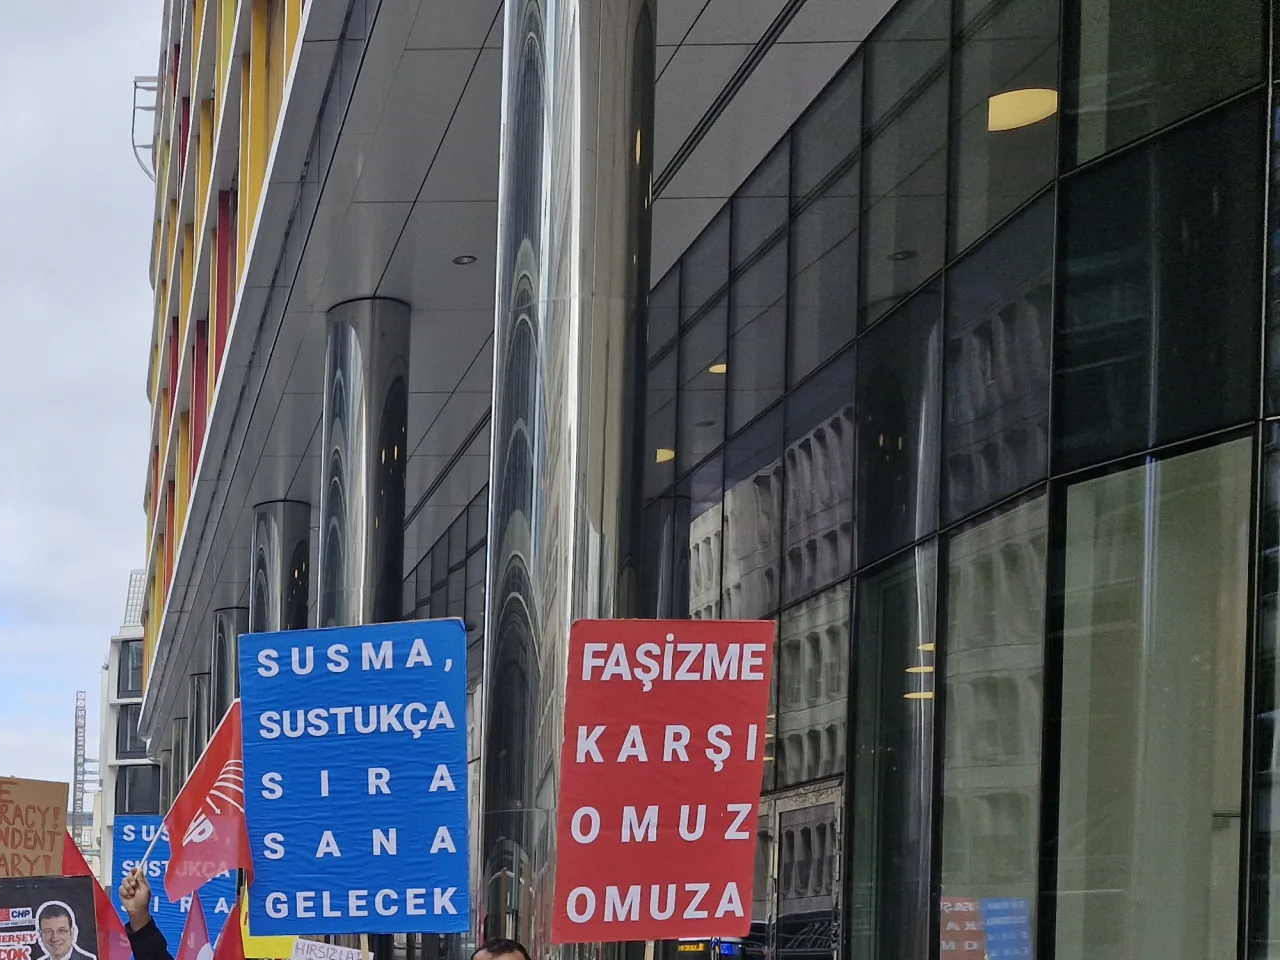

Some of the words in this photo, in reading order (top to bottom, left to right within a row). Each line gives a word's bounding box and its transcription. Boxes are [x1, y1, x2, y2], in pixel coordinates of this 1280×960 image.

[256, 638, 453, 677] SUSMA,
[581, 633, 767, 692] FAŞİZME
[258, 700, 456, 740] SUSTUKÇA
[575, 723, 758, 773] KARŞI
[260, 763, 457, 800] SIRA
[262, 825, 458, 860] SANA
[570, 803, 753, 844] OMUZ
[11, 909, 31, 919] CHP
[264, 886, 458, 919] GELECEK
[565, 881, 745, 924] OMUZA
